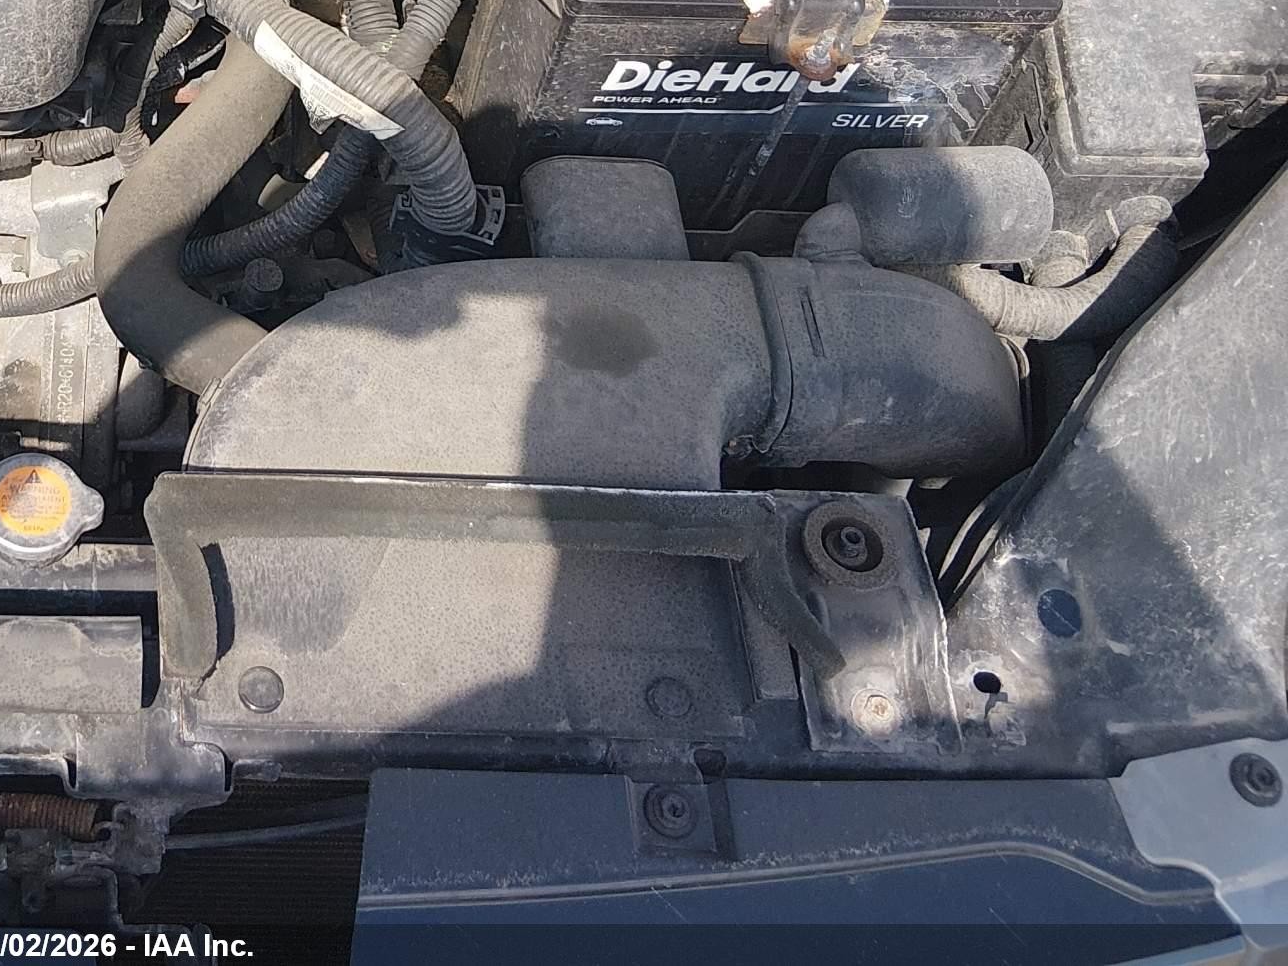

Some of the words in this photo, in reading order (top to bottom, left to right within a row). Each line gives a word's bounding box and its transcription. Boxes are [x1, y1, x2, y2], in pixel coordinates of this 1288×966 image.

[600, 60, 861, 93] DieHard
[592, 95, 655, 104] POWER
[831, 113, 929, 129] SILVER
